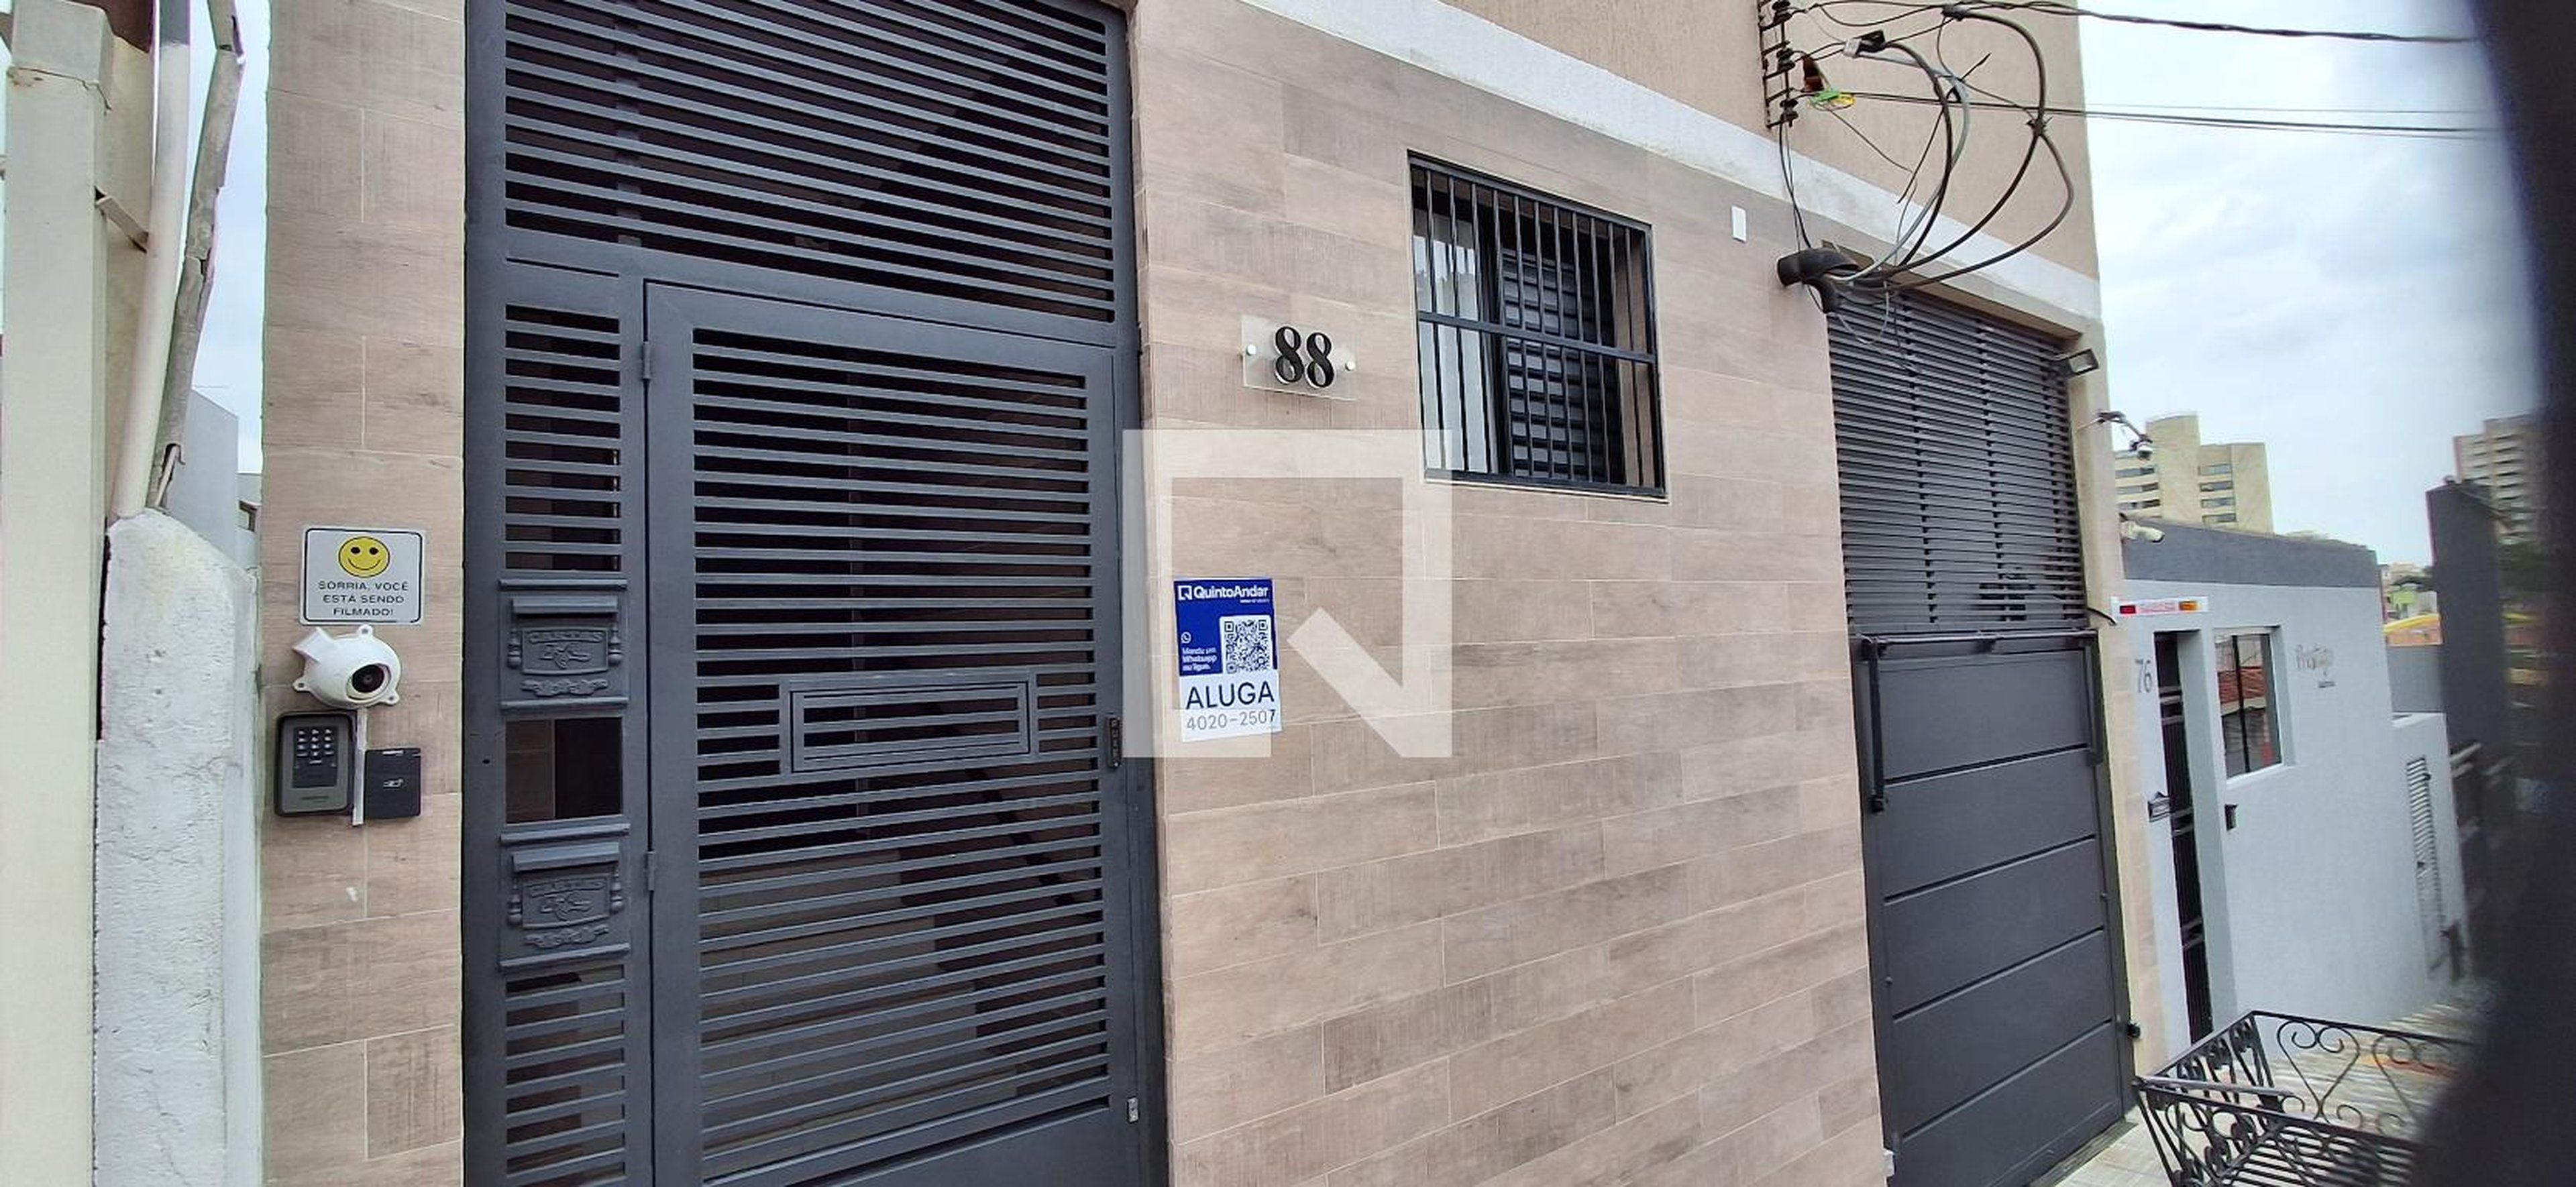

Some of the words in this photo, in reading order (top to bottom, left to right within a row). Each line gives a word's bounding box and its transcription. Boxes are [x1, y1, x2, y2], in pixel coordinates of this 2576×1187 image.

[1275, 326, 1334, 388] 88
[375, 581, 409, 591] VOCÊ
[1194, 585, 1268, 599] QuintoAndar
[361, 594, 404, 604] SENDO
[333, 608, 393, 616] FILMADO!
[2135, 658, 2153, 693] 76
[1186, 681, 1275, 710] ALUGA
[1187, 709, 1276, 730] 4020-2507
